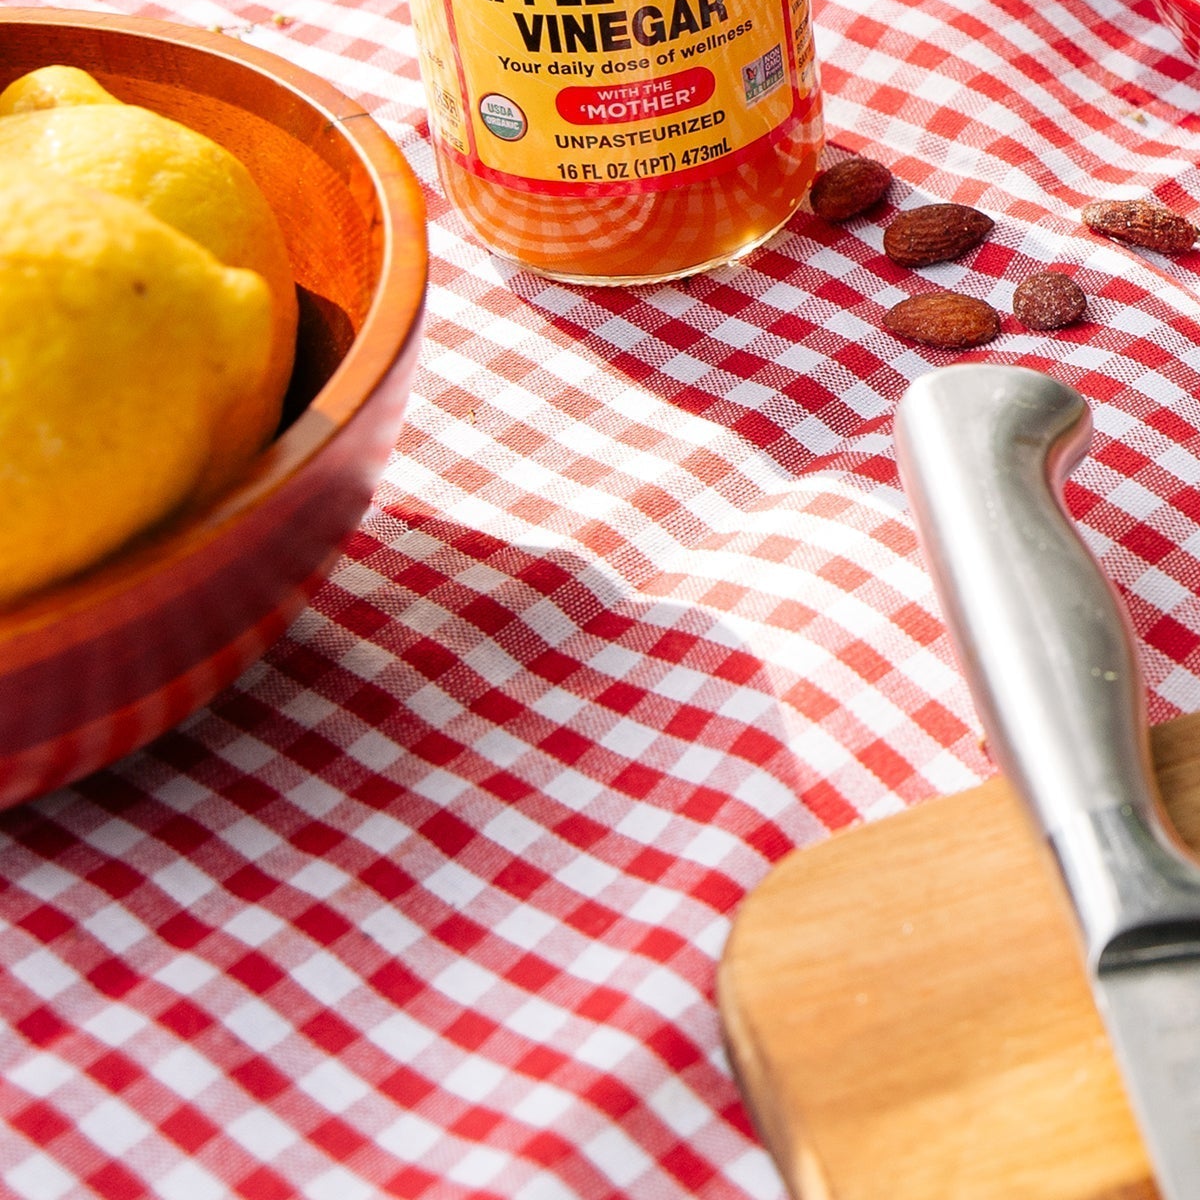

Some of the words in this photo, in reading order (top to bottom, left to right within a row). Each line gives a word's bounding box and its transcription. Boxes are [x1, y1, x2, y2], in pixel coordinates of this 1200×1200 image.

[498, 56, 541, 75] Your
[549, 61, 595, 78] daily
[601, 57, 650, 74] dose
[656, 48, 676, 66] of
[681, 19, 753, 59] wellness
[487, 103, 514, 118] USDA
[597, 86, 640, 101] WITH
[643, 80, 672, 95] THE
[555, 109, 726, 149] UNPASTEURIZED
[557, 163, 577, 180] 16
[583, 164, 601, 179] FL
[607, 163, 629, 179] OZ
[634, 152, 677, 179] (1PT)
[681, 137, 732, 167] 473mL
